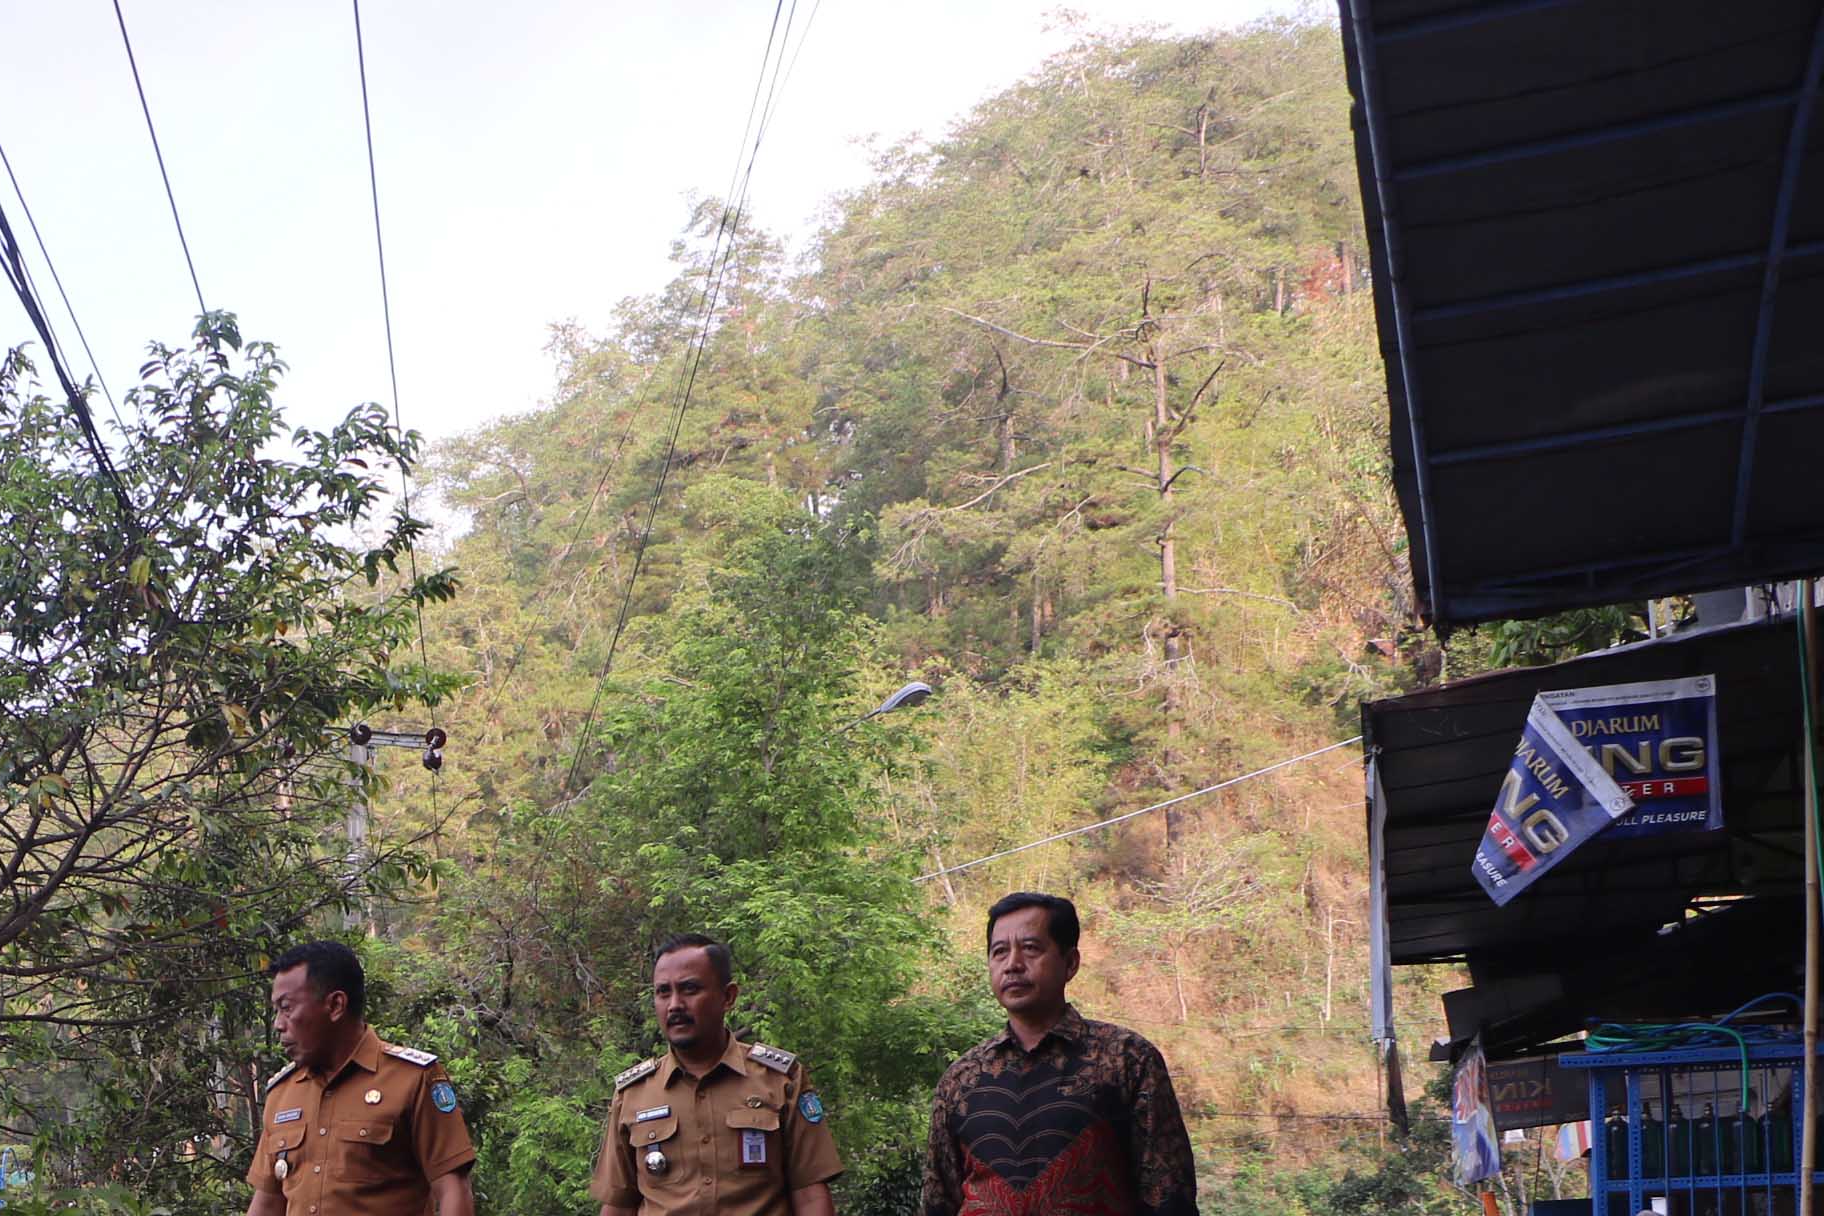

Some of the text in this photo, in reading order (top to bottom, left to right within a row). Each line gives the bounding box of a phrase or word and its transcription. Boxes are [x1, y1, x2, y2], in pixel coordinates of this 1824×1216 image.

[1570, 714, 1661, 738] DJARUM
[1584, 736, 1705, 776] NG
[1641, 810, 1708, 825] PLEASURE
[1476, 848, 1508, 888] EASURE
